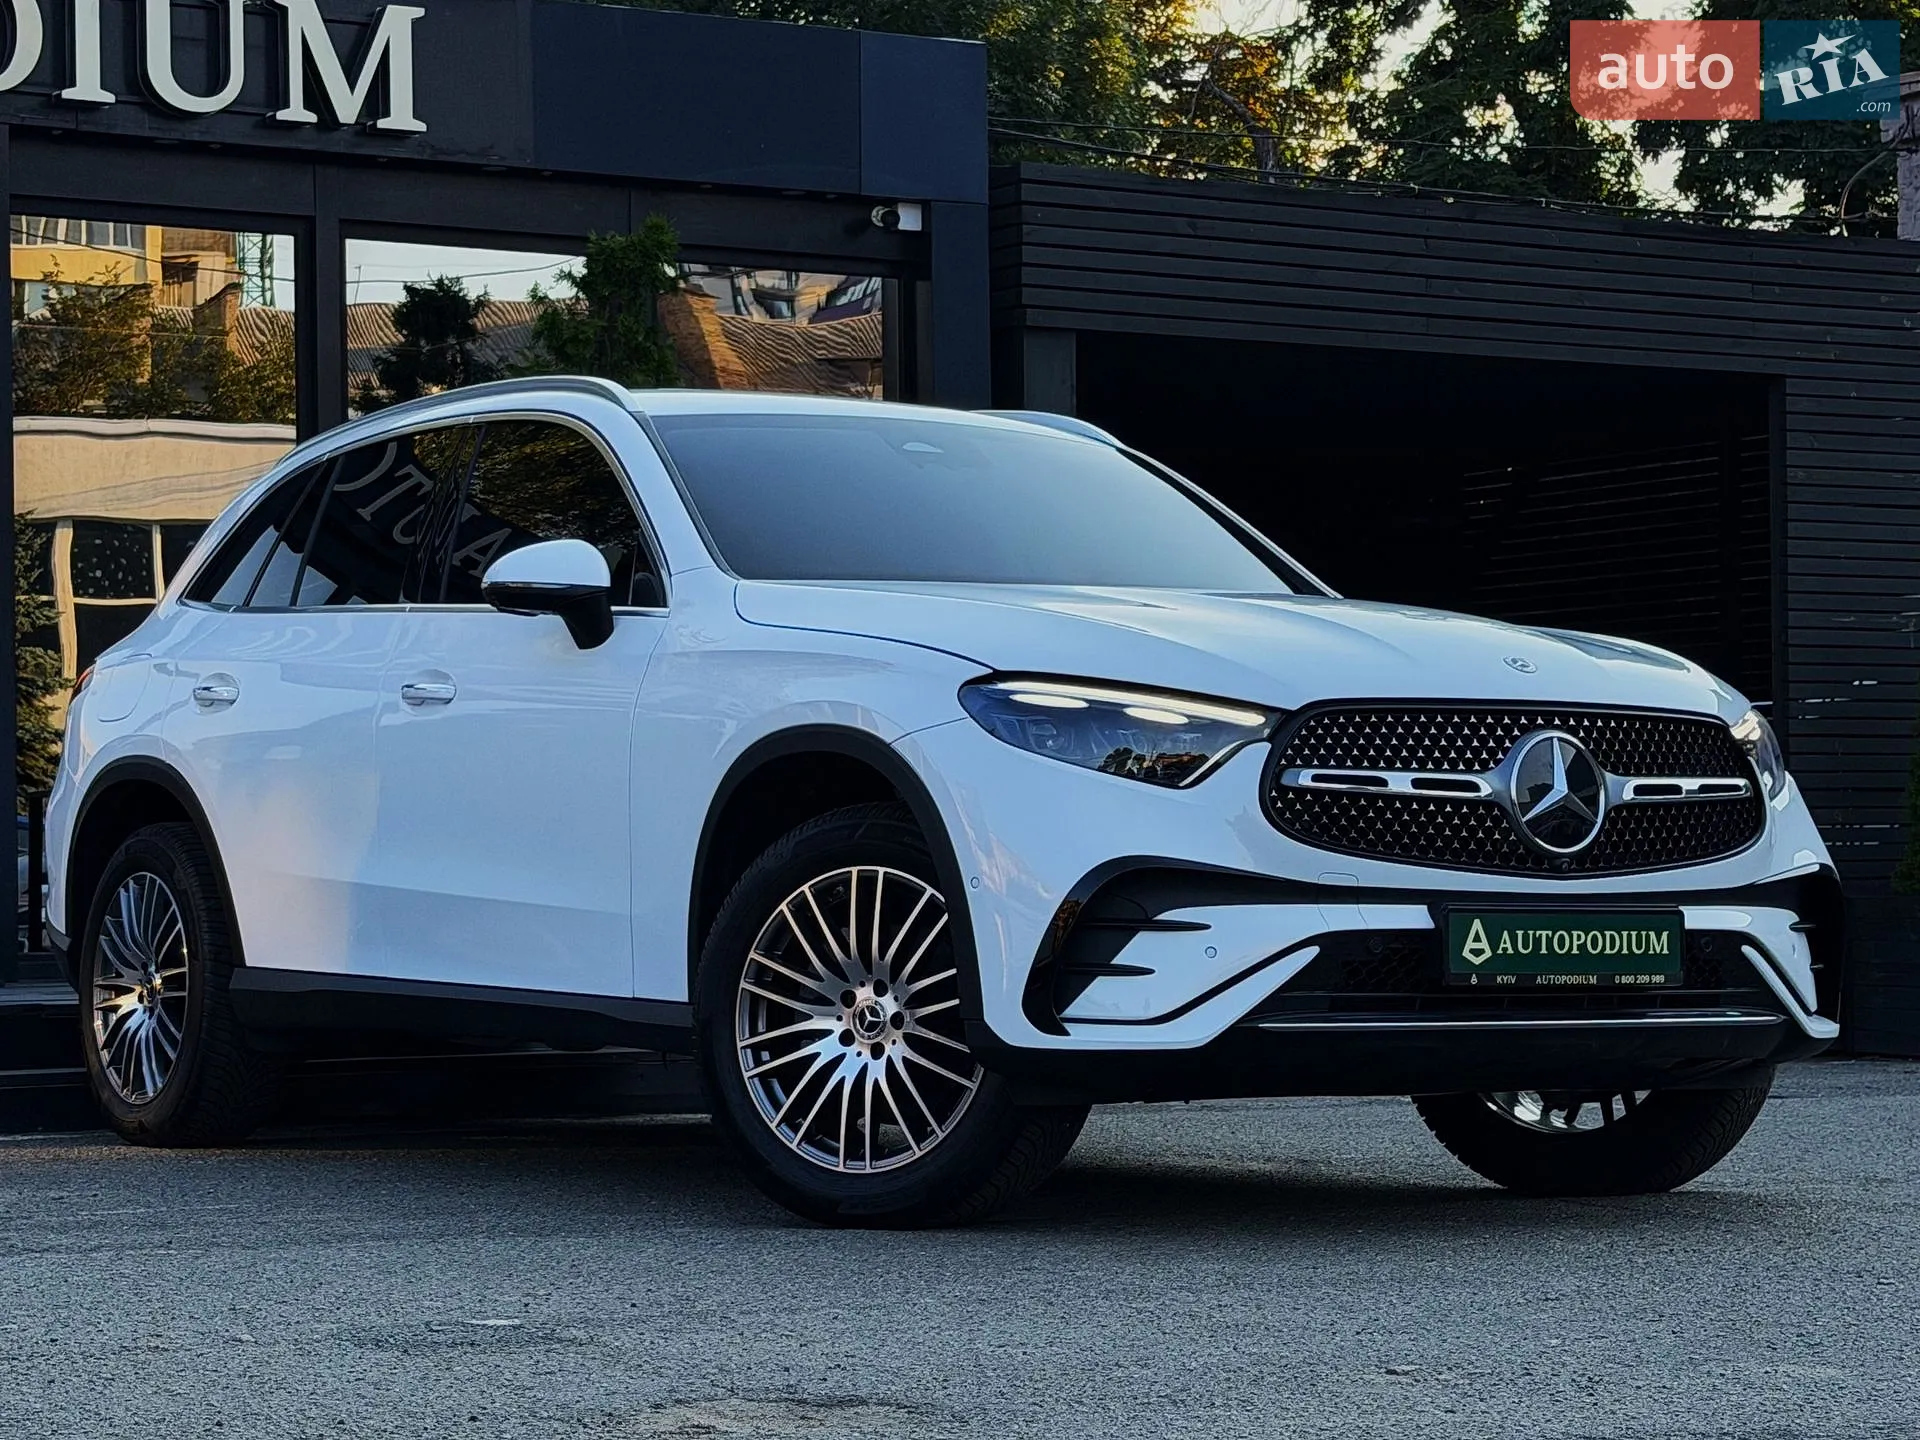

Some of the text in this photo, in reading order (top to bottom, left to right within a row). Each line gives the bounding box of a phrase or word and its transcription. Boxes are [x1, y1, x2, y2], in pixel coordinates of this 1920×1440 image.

[1496, 930, 1670, 954] AUTOPODIUM
[1496, 975, 1516, 984] KYIV
[1536, 975, 1597, 984] AUTOPODIUM
[1614, 975, 1620, 984] 0
[1621, 975, 1635, 984] 800
[1636, 975, 1650, 984] 209
